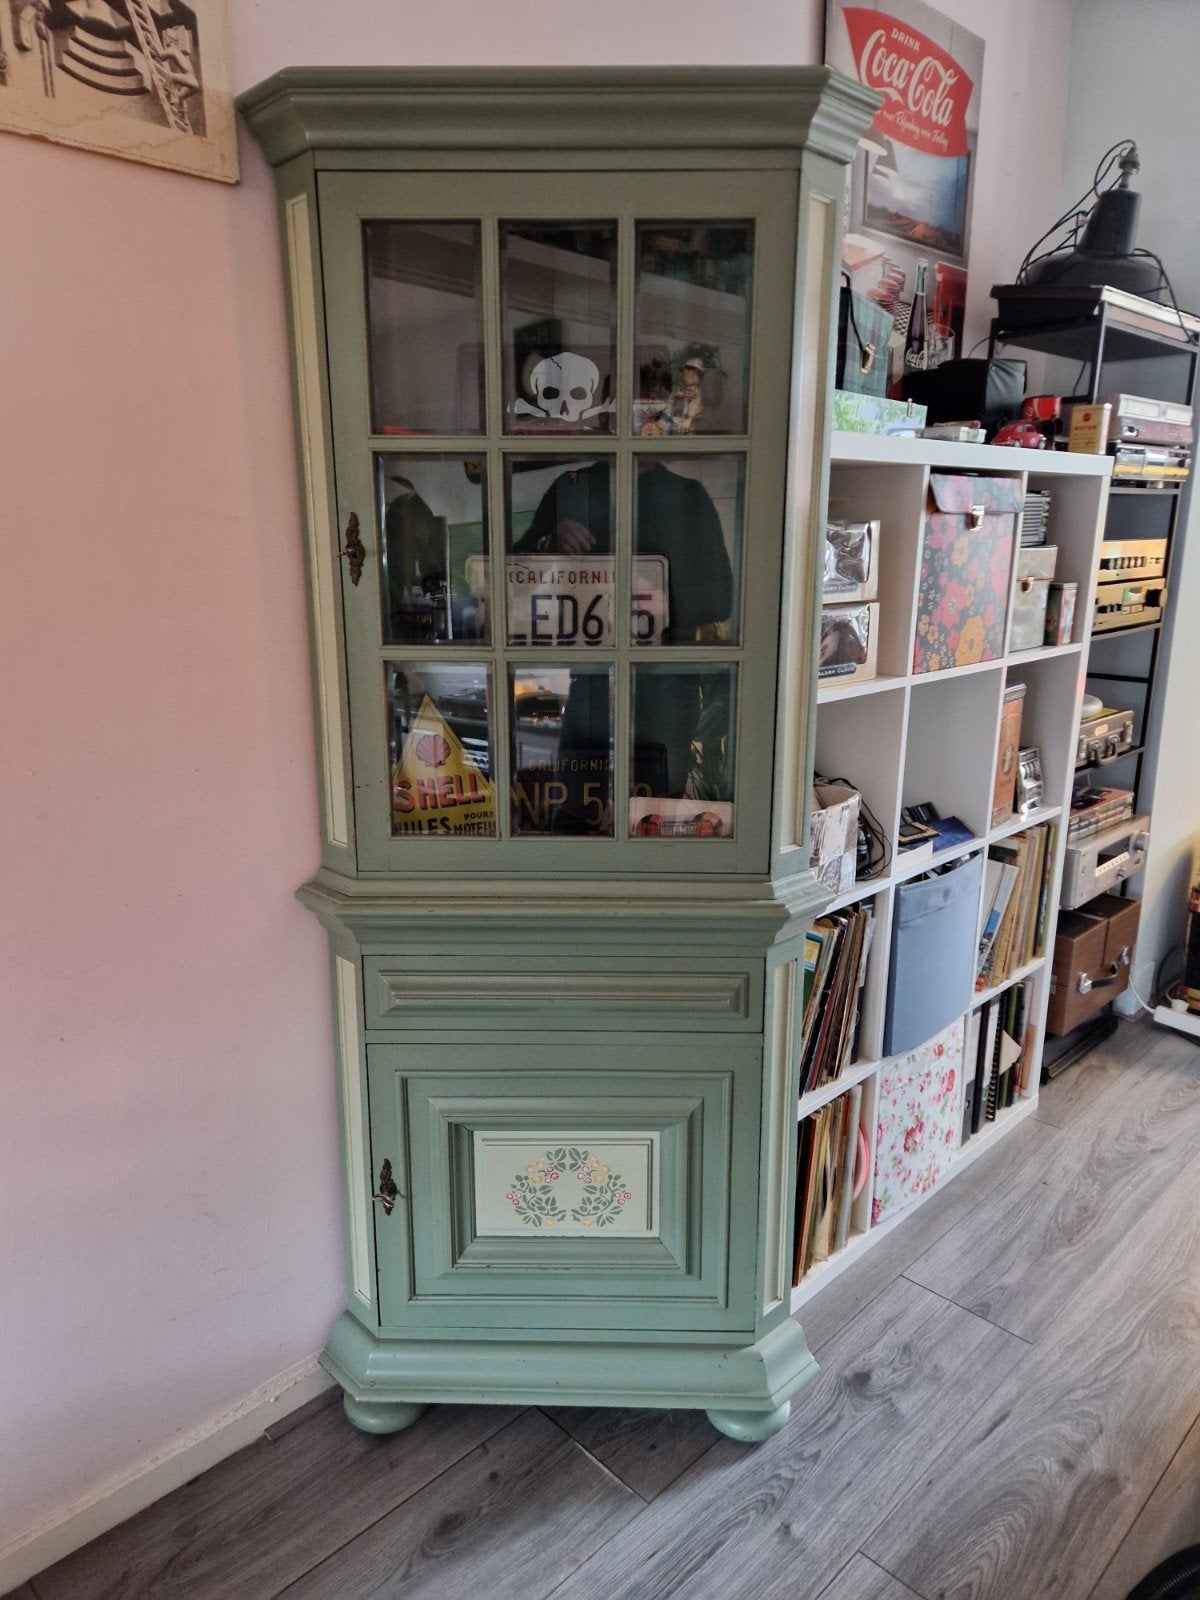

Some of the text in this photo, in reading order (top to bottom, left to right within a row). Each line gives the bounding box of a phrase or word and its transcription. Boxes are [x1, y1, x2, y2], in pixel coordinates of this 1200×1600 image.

[891, 28, 922, 51] DRINK
[860, 29, 959, 128] Coca-Cola
[511, 570, 615, 585] CALIFORNI
[392, 772, 486, 814] SHELL
